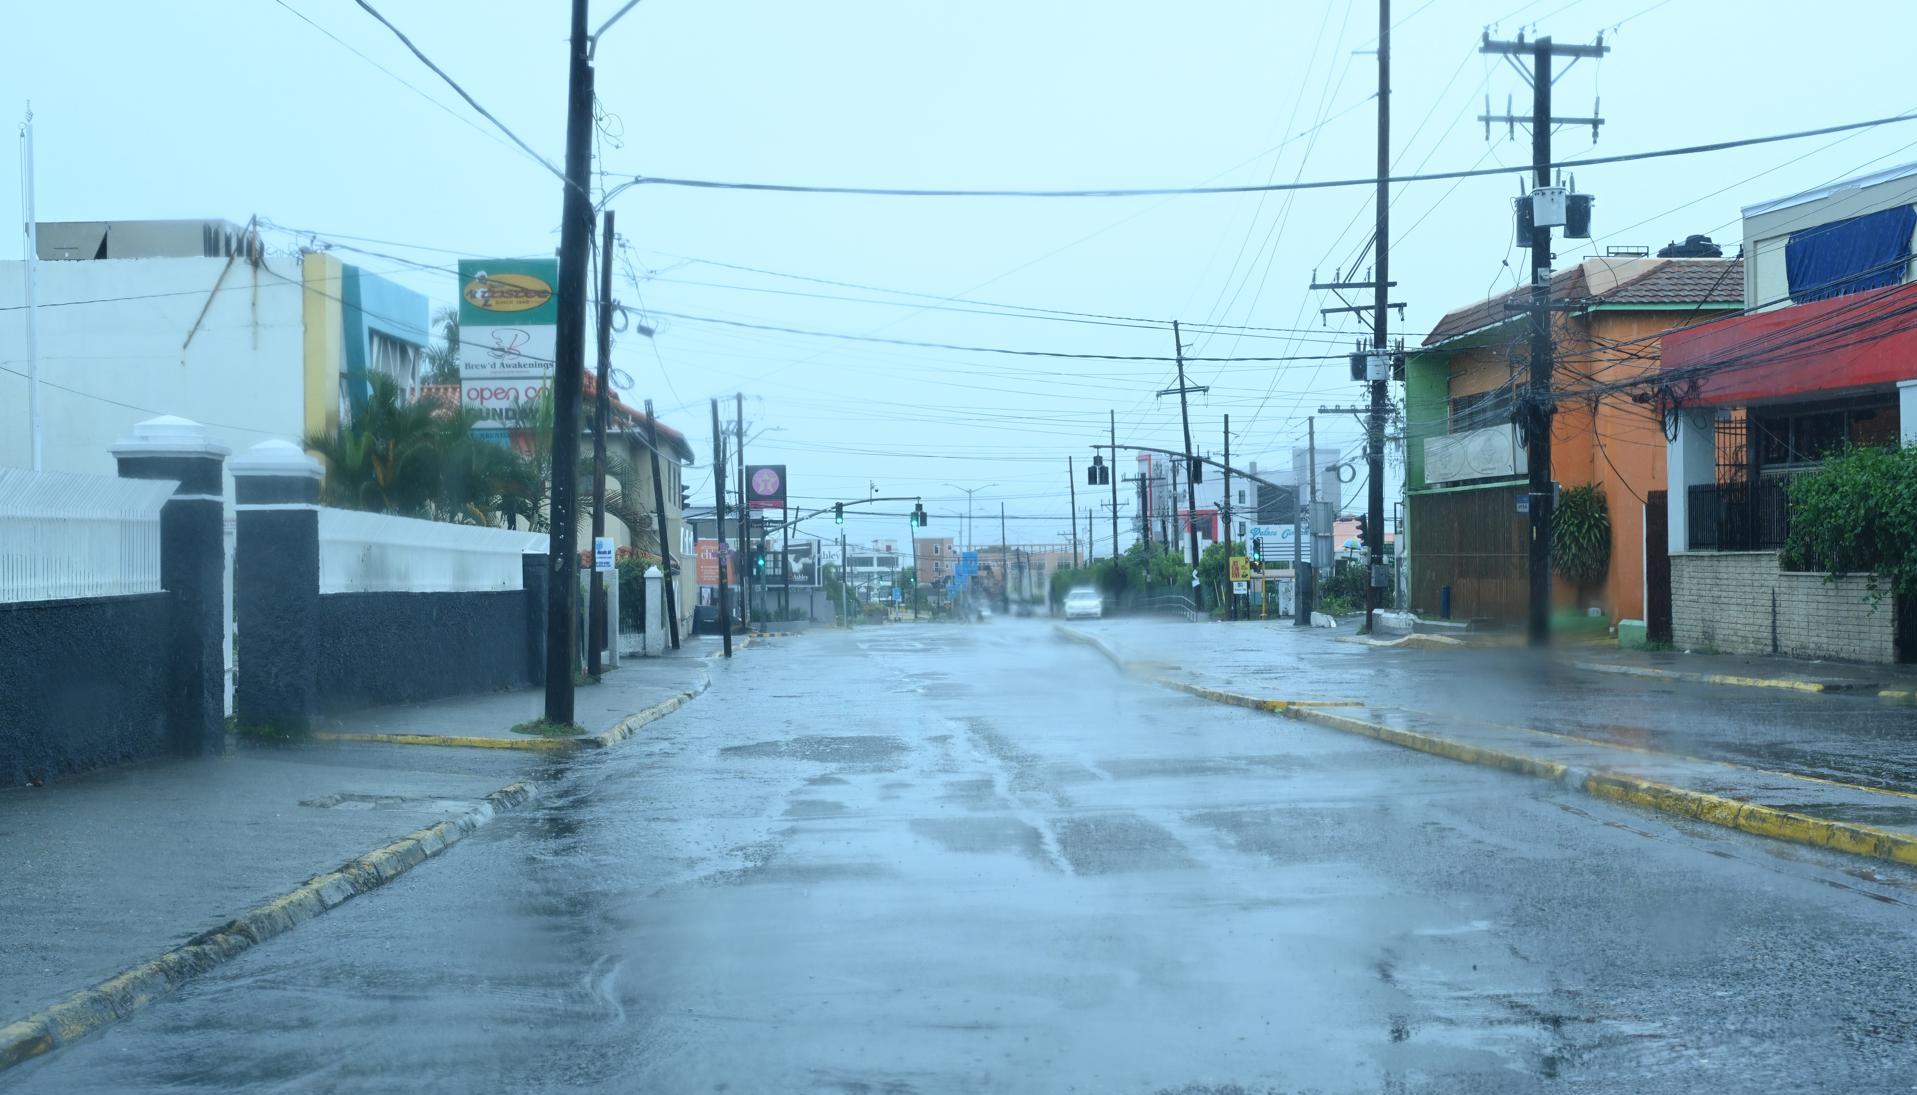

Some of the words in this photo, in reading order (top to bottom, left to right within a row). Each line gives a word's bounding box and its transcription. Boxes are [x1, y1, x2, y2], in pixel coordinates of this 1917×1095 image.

[464, 361, 497, 370] Brew'd
[499, 360, 554, 370] Awakenings
[467, 386, 519, 406] open
